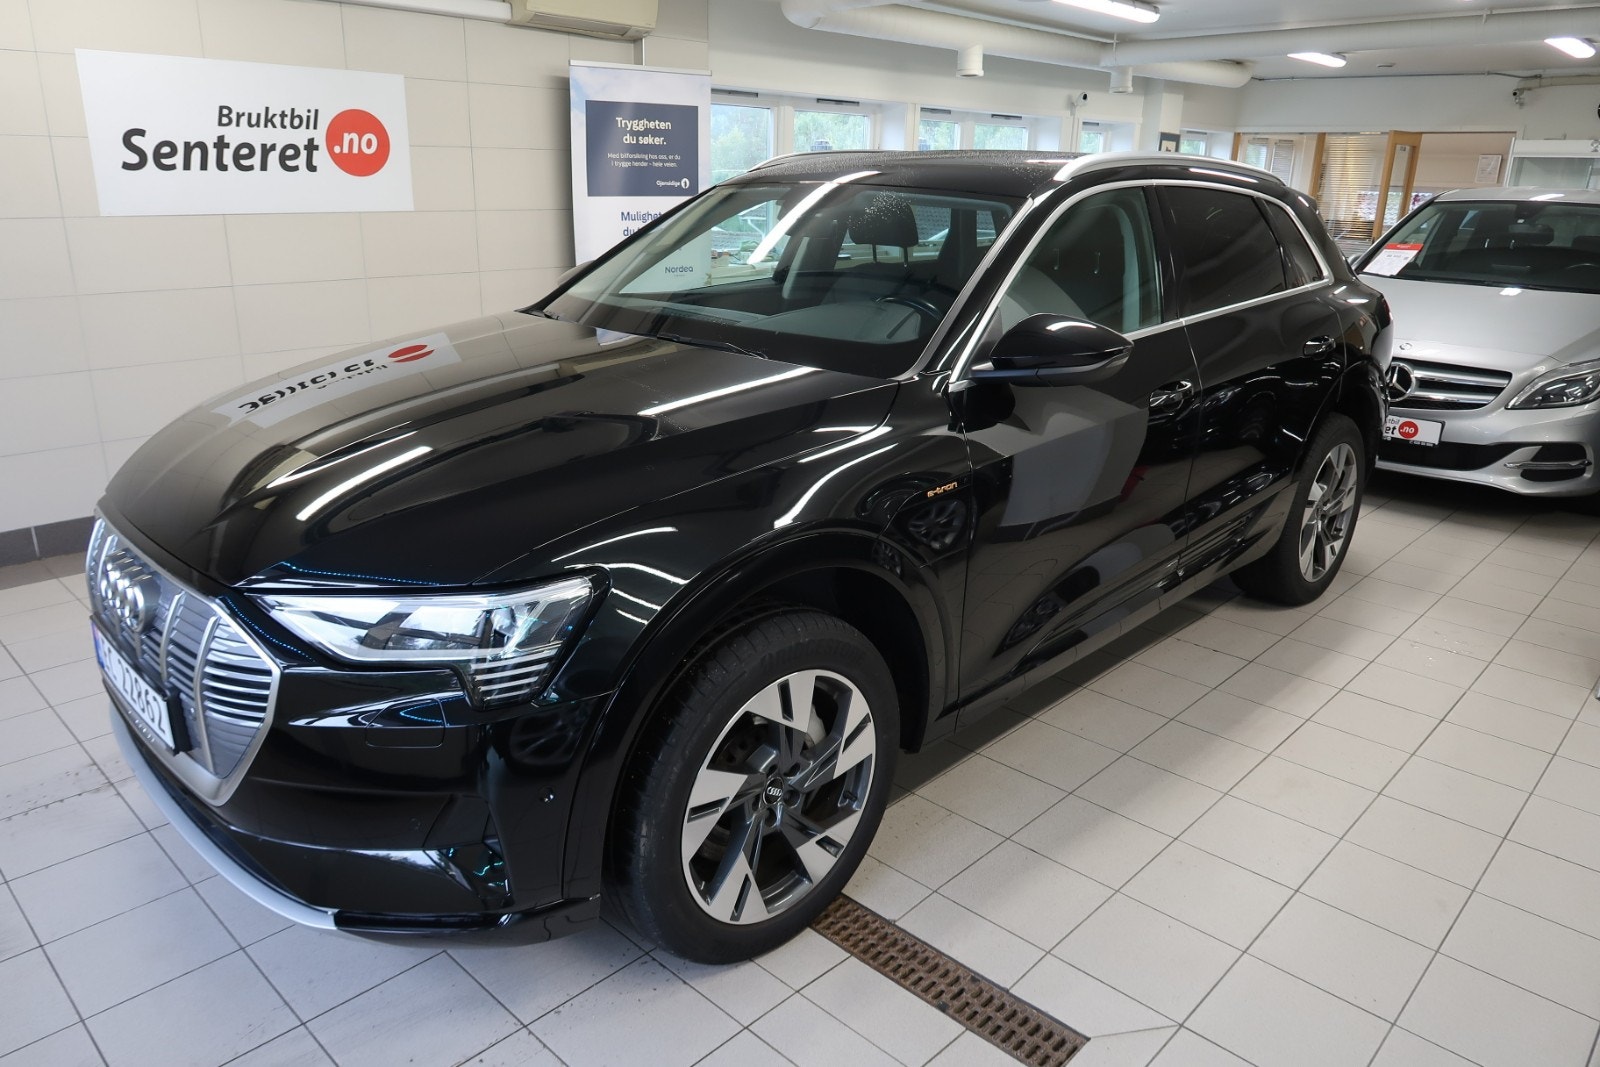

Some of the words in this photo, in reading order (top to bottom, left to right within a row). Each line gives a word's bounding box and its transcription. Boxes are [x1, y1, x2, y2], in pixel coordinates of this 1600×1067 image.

[217, 105, 320, 130] Bruktbil
[615, 117, 672, 131] Tryggheten
[622, 133, 637, 144] du
[638, 134, 667, 145] søker.
[121, 127, 320, 173] Senteret
[333, 131, 378, 155] .no
[656, 180, 681, 188] Gjensidige
[620, 211, 664, 224] Mulighet
[664, 265, 694, 274] Nordea
[1399, 426, 1415, 434] .no
[927, 481, 958, 498] e-tron
[117, 657, 167, 736] 22862
